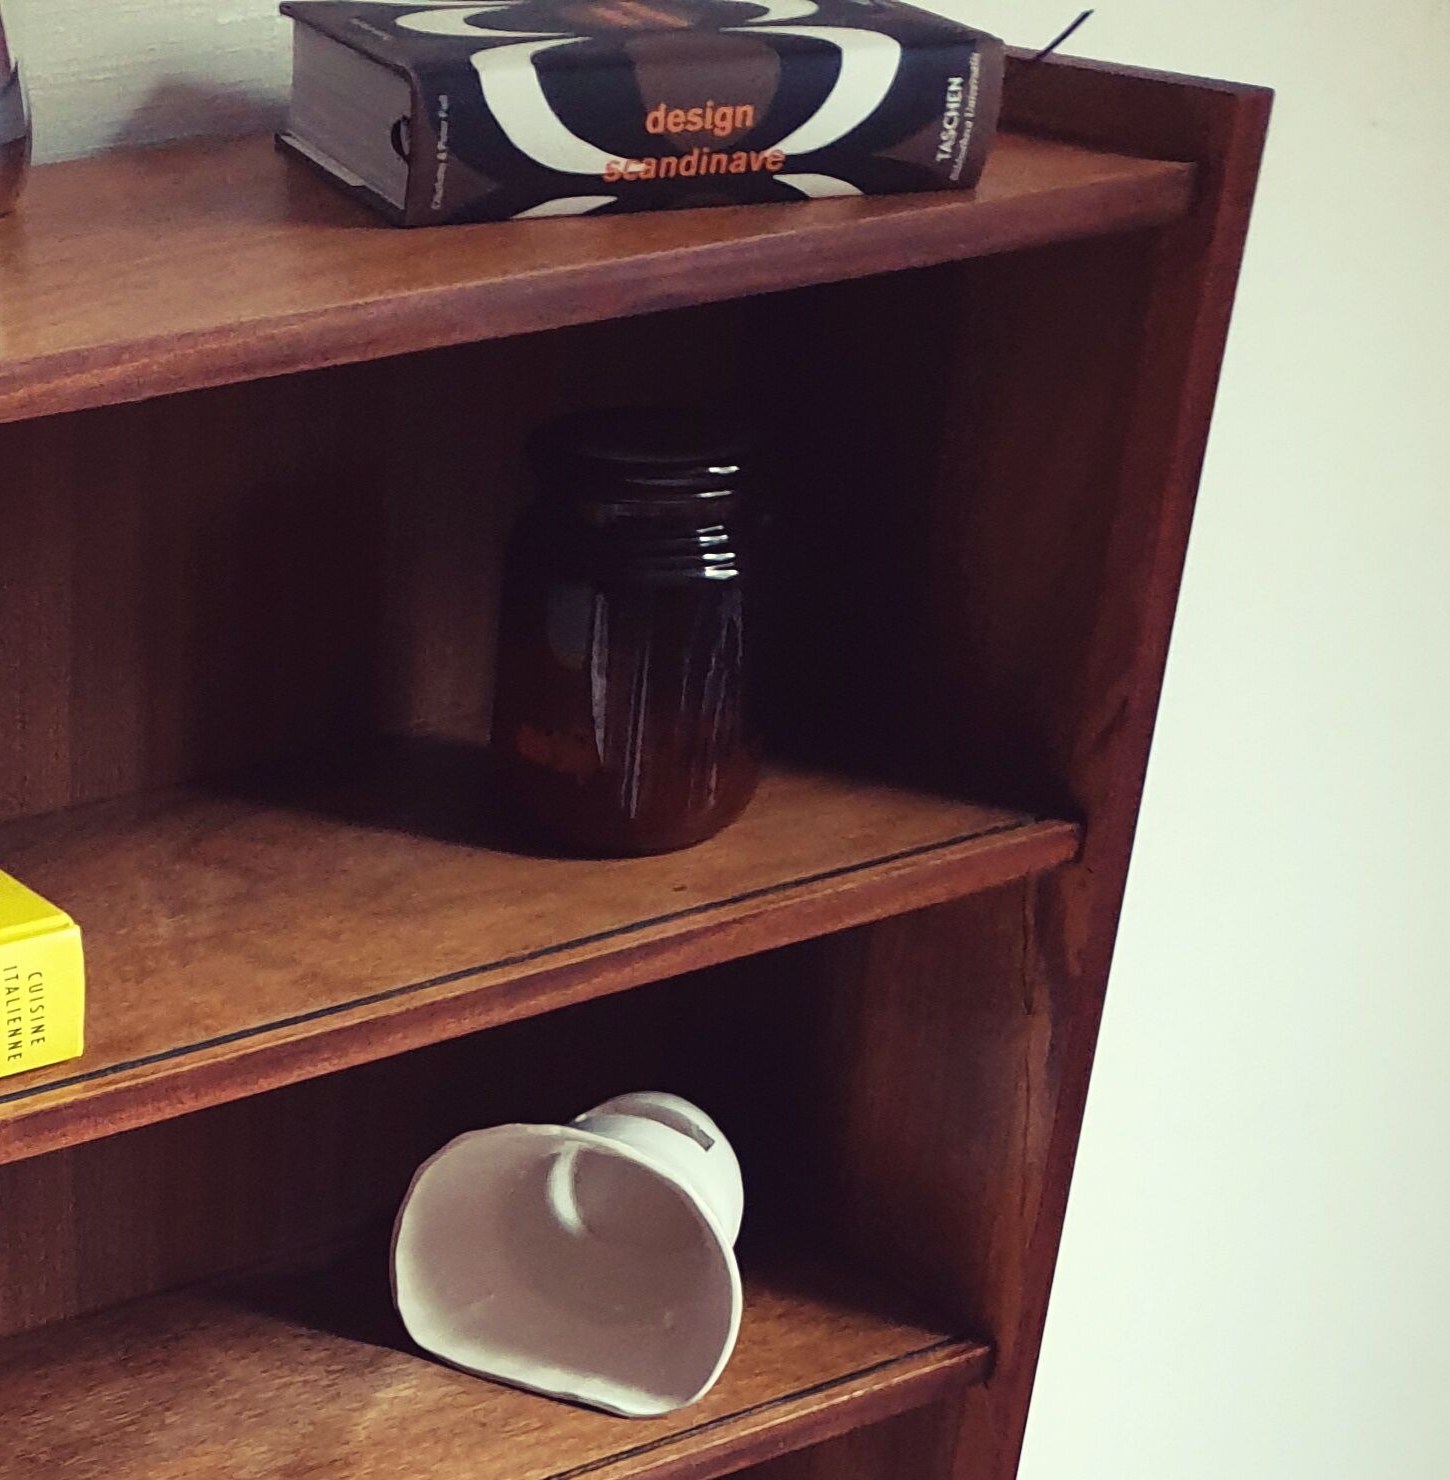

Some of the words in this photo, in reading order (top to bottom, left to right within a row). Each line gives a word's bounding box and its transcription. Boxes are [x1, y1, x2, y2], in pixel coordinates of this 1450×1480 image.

[646, 100, 755, 137] design
[935, 77, 963, 161] TASCHEN
[603, 147, 786, 183] scandinave
[3, 965, 22, 1062] ITALIENNE
[28, 971, 46, 1046] CUISINE
